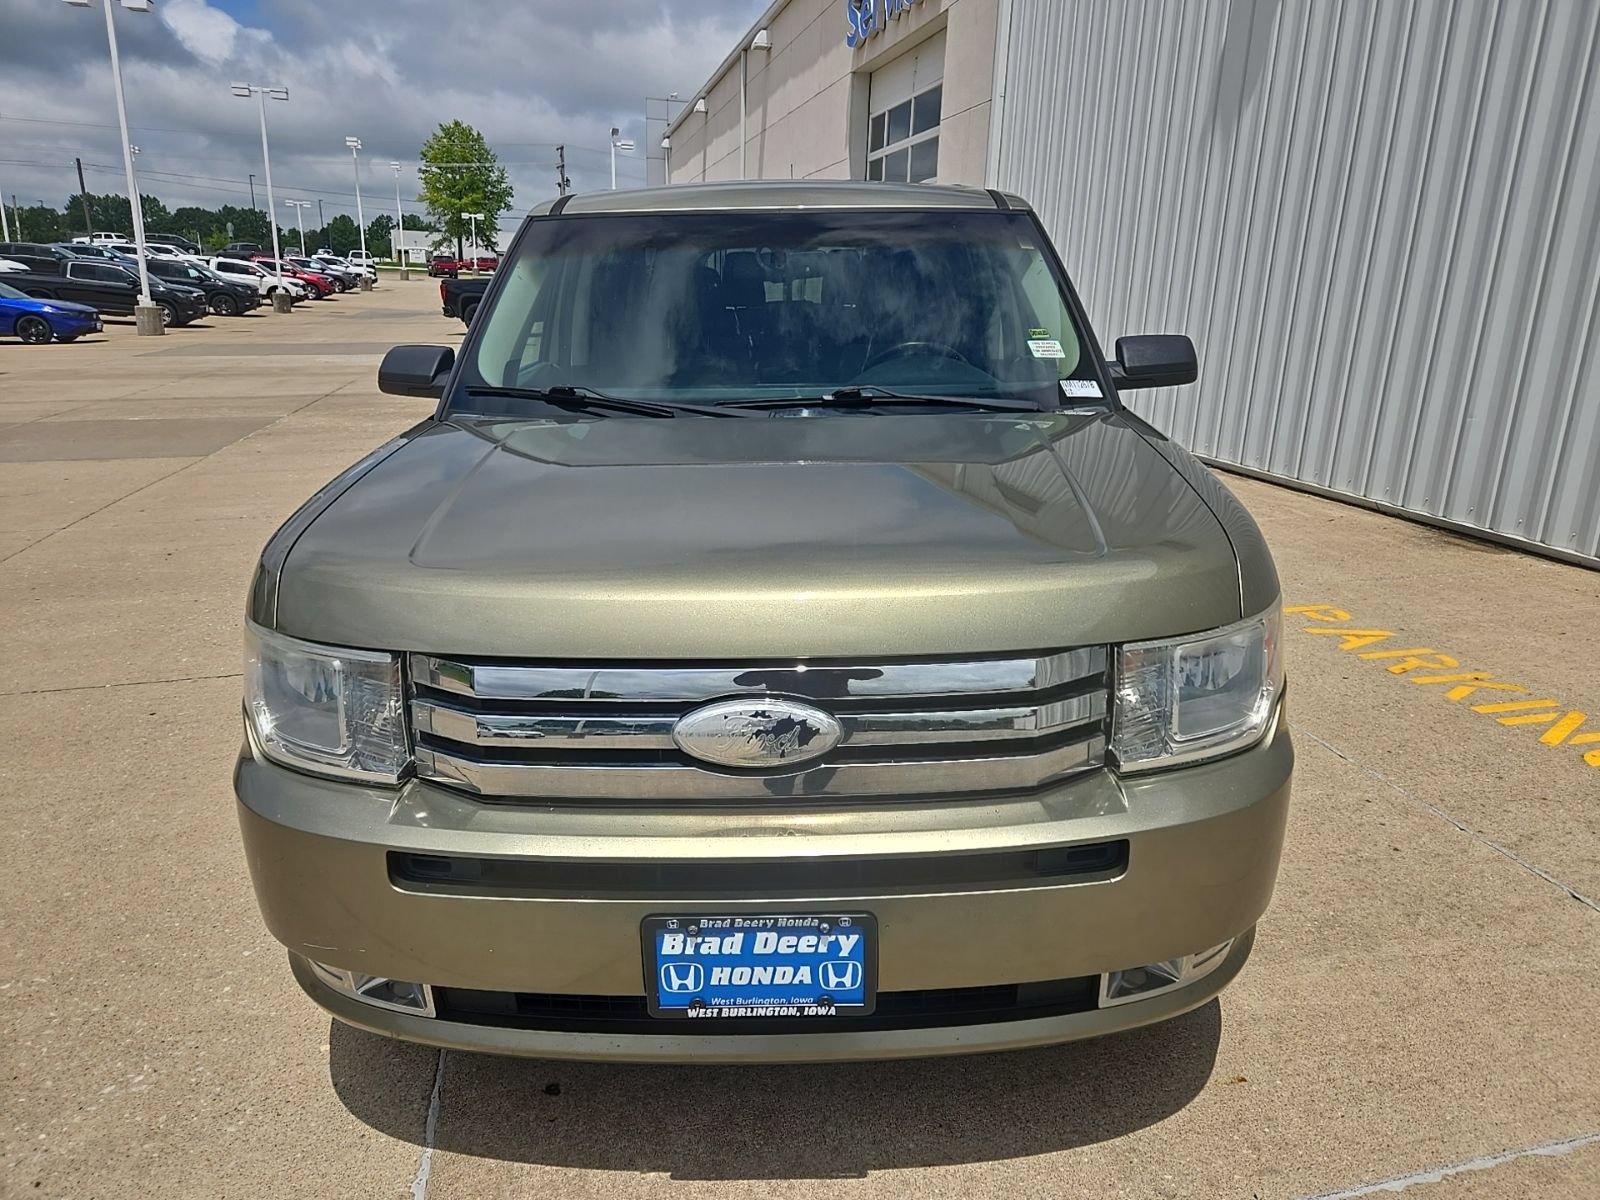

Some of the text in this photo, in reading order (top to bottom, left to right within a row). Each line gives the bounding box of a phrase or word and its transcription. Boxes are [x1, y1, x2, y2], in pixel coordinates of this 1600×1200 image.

[1282, 604, 1600, 768] PARKIN
[700, 917, 819, 929] Brad Deery Honda
[661, 931, 860, 957] Brad Deery
[710, 966, 812, 986] HONDA
[711, 997, 734, 1006] West
[791, 996, 814, 1005] Iowa
[687, 1006, 837, 1018] WEST BURLINGTON, IOWA
